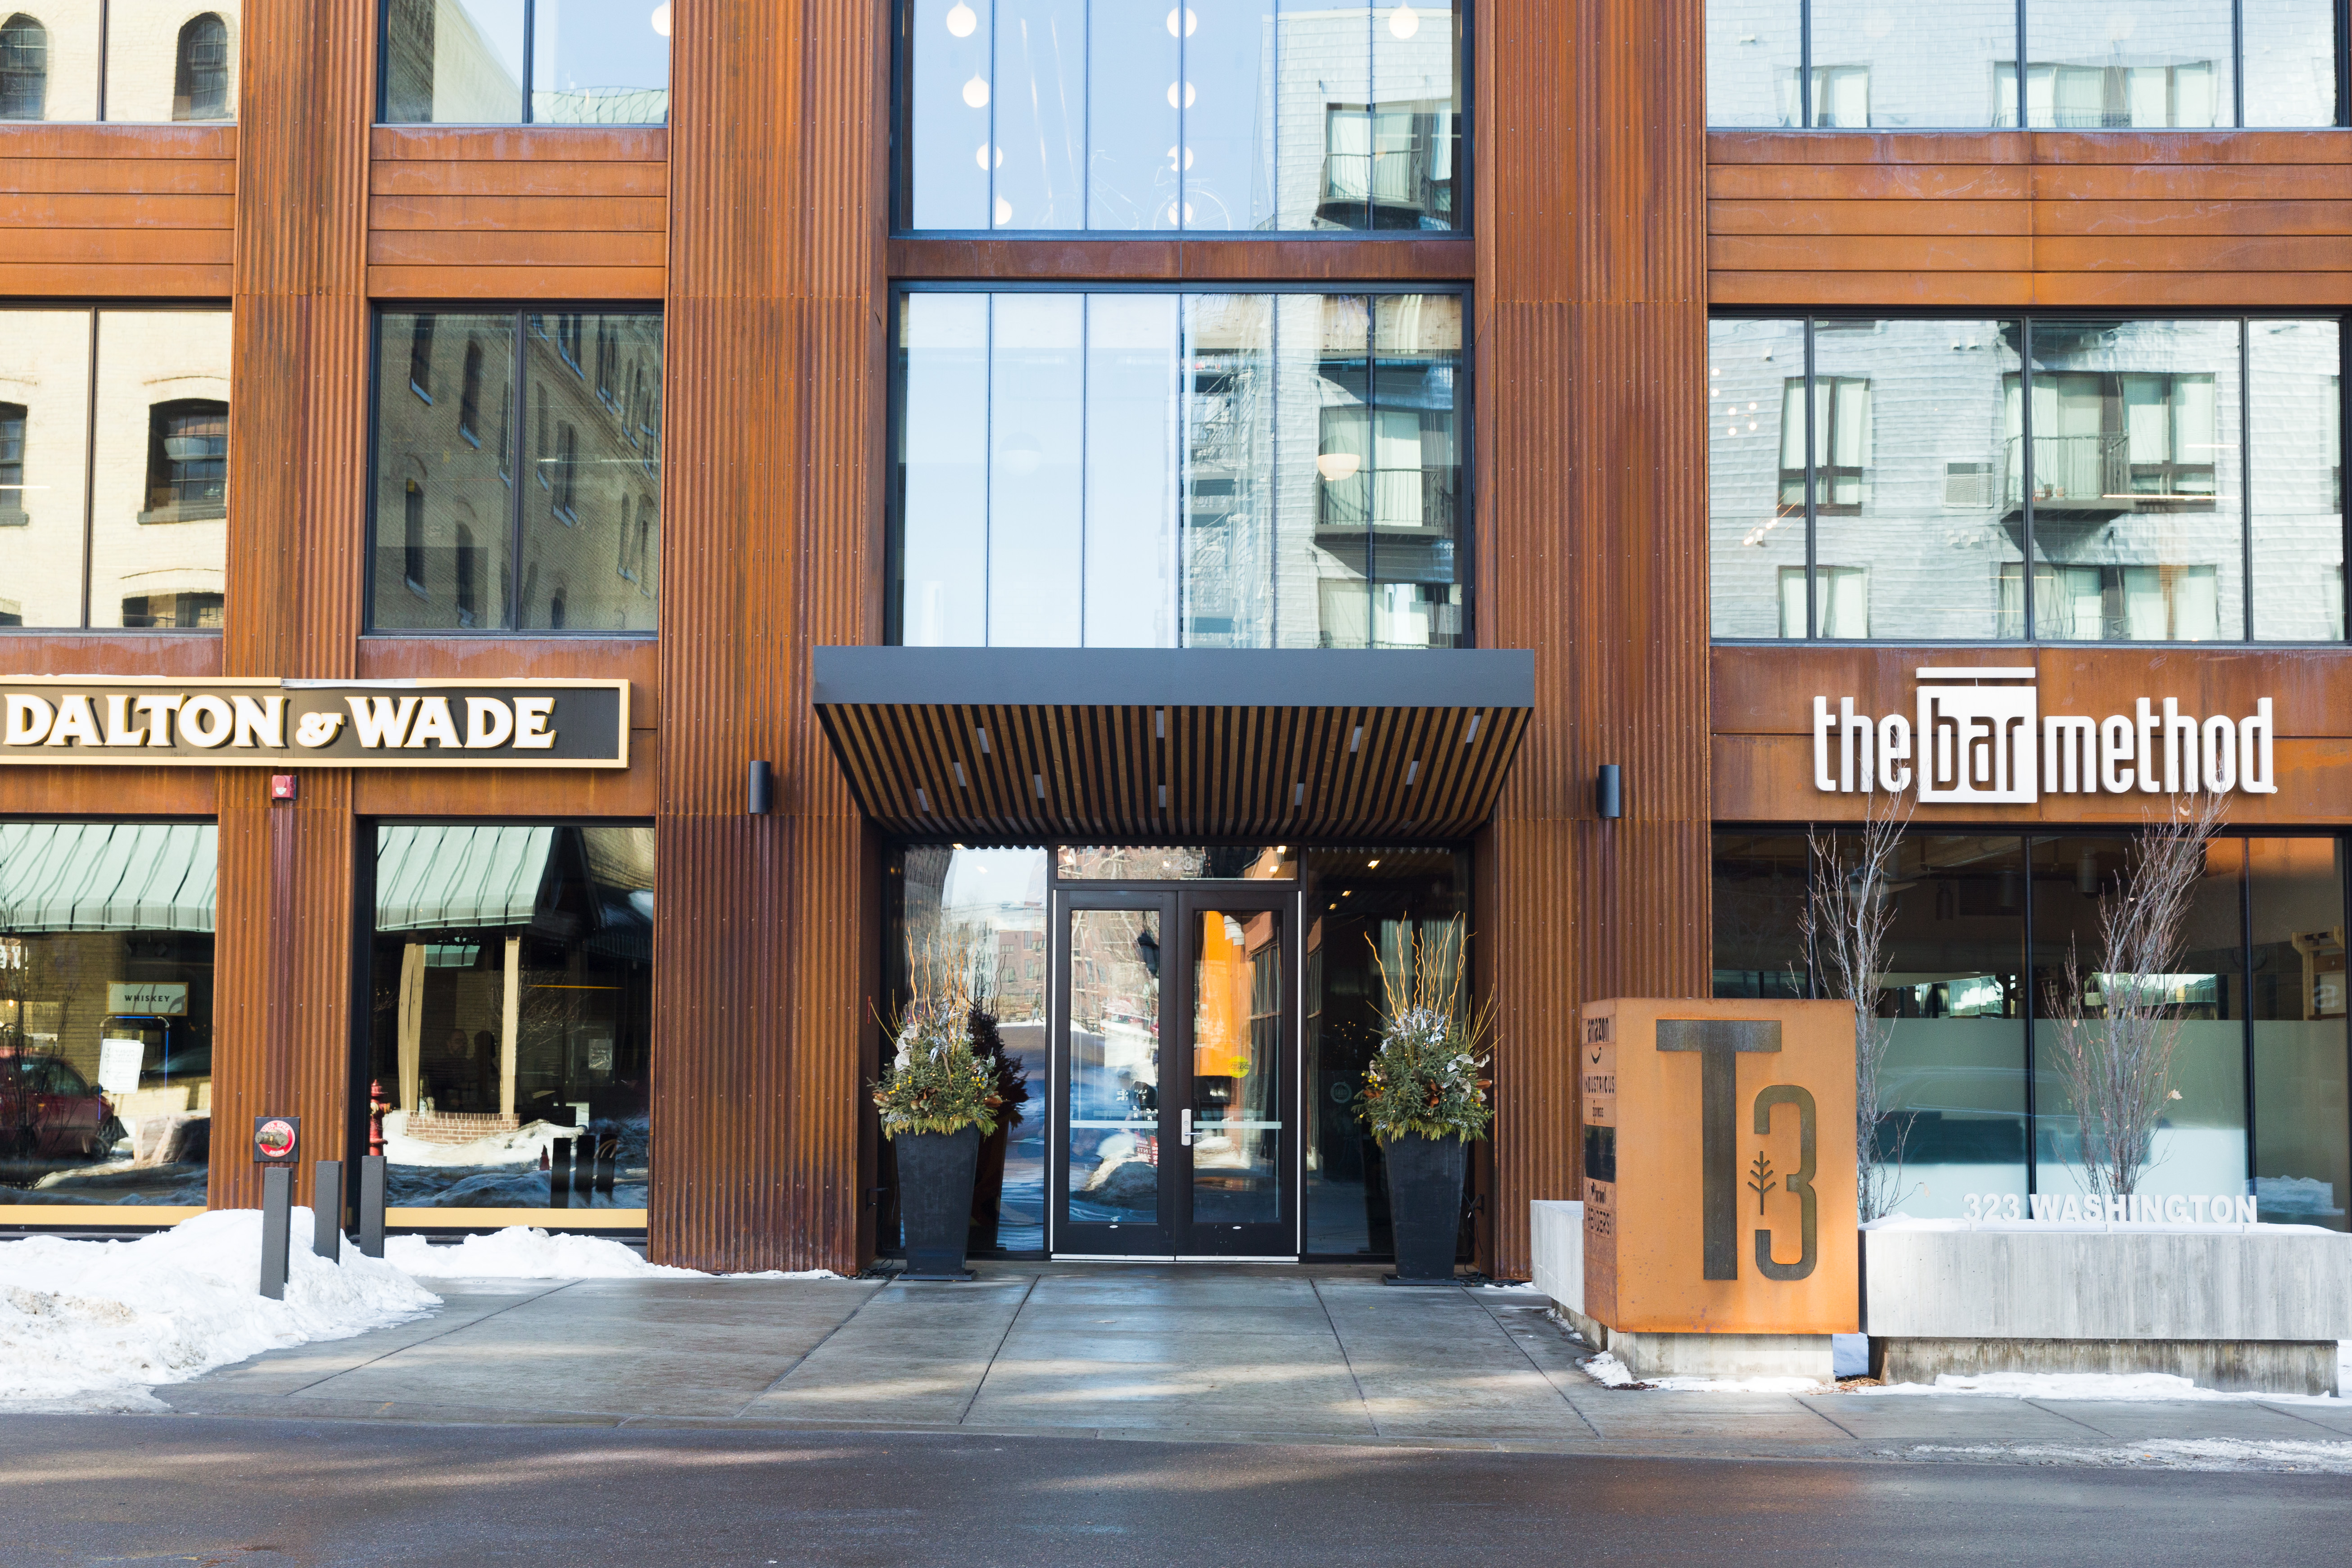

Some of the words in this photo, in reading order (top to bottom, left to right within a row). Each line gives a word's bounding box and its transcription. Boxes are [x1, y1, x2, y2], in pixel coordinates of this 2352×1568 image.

[4, 693, 289, 749] DALTON
[295, 712, 345, 748] &
[345, 696, 557, 750] WADE
[1813, 696, 1911, 792] the
[1931, 697, 2025, 791] bar
[2044, 697, 2273, 794] method
[1163, 855, 1193, 870] 323
[1588, 1017, 1609, 1044] amazon
[1962, 1193, 2021, 1221] 323
[2029, 1193, 2257, 1223] WASHINGTON
